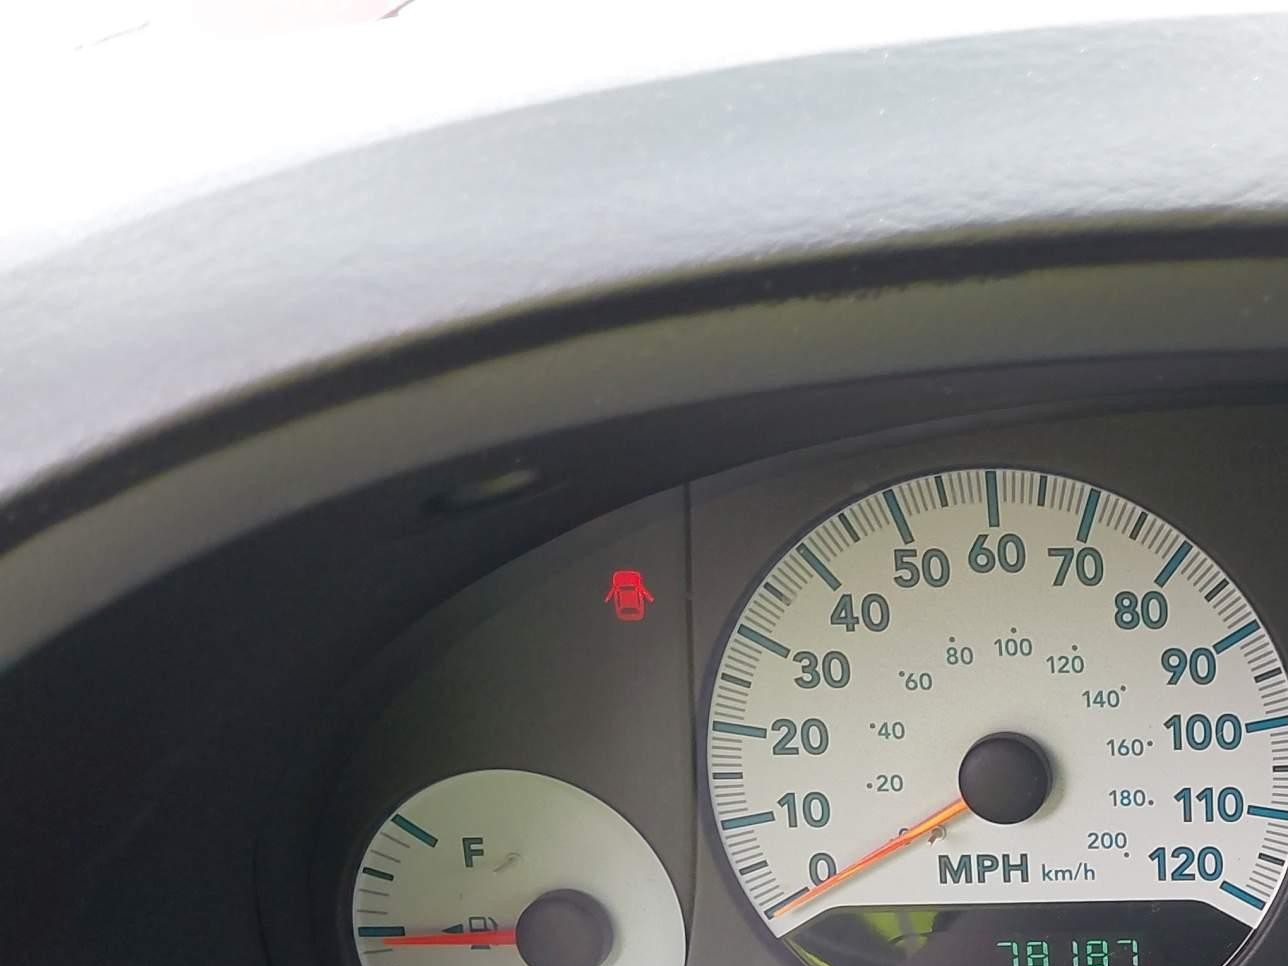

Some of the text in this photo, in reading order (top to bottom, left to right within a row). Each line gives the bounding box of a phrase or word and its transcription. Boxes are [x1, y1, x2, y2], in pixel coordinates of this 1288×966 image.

[892, 548, 951, 588] 50
[968, 534, 1026, 574] 60
[1047, 547, 1104, 587] 70
[830, 594, 890, 632] 40
[1114, 592, 1168, 630] 80
[946, 647, 973, 665] 80
[994, 638, 1033, 657] 100
[1046, 655, 1084, 674] 120
[793, 651, 851, 689] 30
[905, 672, 933, 692] 60
[1160, 648, 1217, 686] 90
[1082, 690, 1120, 708] 140
[771, 718, 829, 756] 20
[878, 722, 905, 740] 40
[1107, 739, 1145, 757] 160
[1163, 714, 1243, 750] 100
[876, 775, 904, 793] 20
[1109, 790, 1147, 807] 180
[777, 792, 831, 829] 10
[1174, 787, 1245, 823] 110
[462, 838, 484, 868] F
[1087, 832, 1127, 851] 200
[808, 853, 837, 888] 0
[938, 854, 1096, 884] MPH km/h
[1148, 846, 1225, 881] 120
